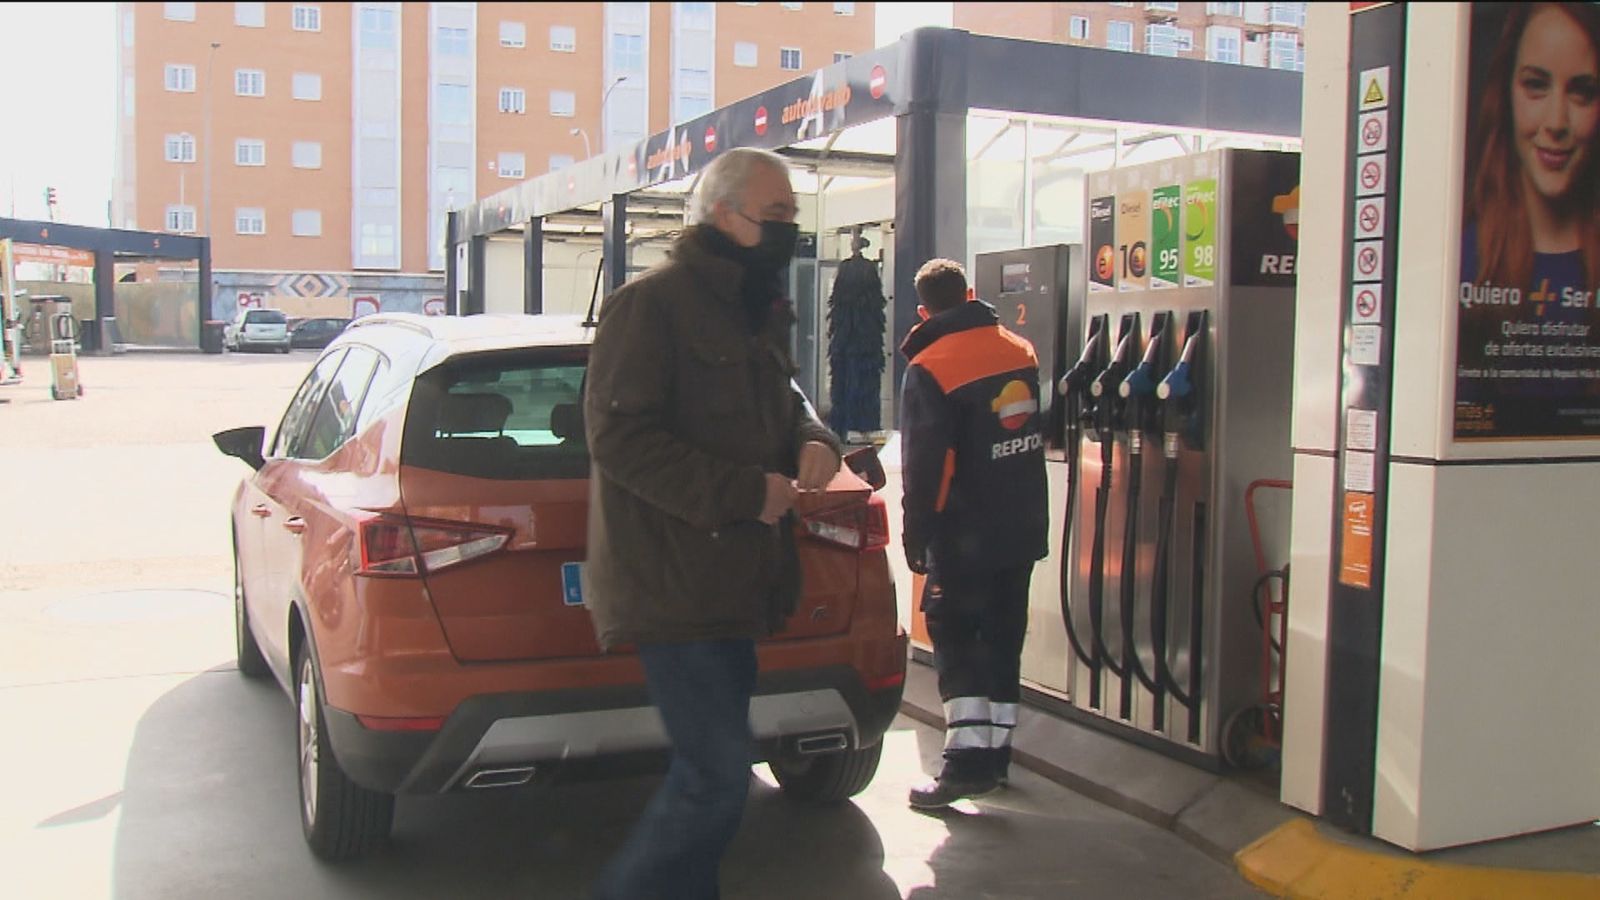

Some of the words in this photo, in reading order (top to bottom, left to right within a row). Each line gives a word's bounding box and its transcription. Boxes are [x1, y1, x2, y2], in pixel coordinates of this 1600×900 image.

[1160, 248, 1178, 270] 95
[1194, 245, 1214, 267] 98
[1260, 254, 1298, 275] RE
[1460, 280, 1521, 308] Quiero
[1561, 286, 1592, 308] Ser
[1016, 303, 1026, 325] 2
[1502, 320, 1539, 337] Quiero
[1541, 321, 1590, 336] disfrutar
[1485, 341, 1499, 356] de
[1502, 341, 1543, 356] ofertas
